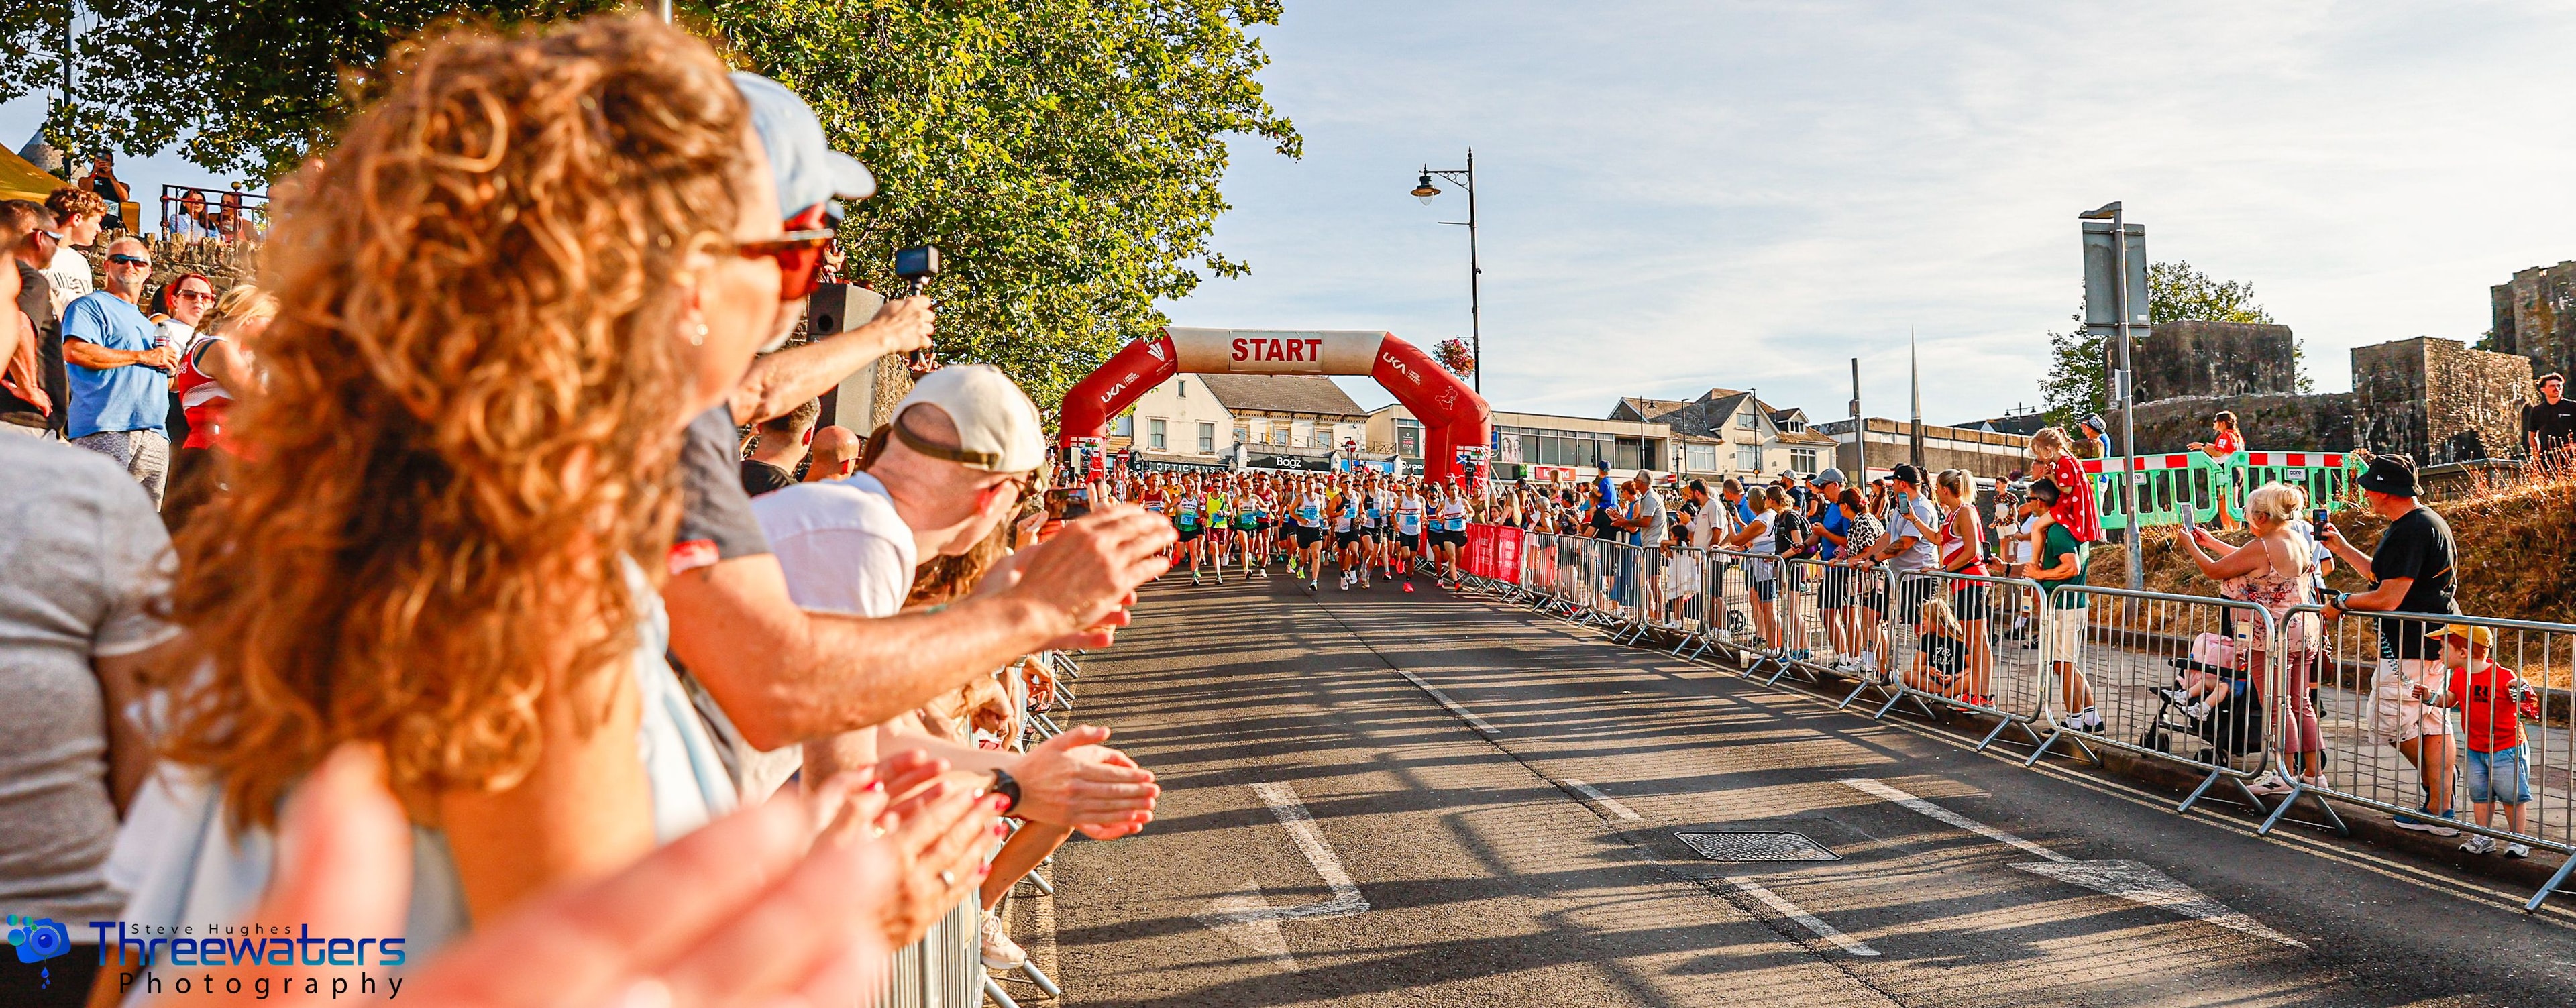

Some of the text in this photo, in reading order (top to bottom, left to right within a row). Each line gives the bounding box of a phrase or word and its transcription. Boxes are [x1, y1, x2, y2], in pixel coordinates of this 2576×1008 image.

[1232, 338, 1322, 362] START
[1382, 351, 1405, 375] UKA
[1100, 382, 1126, 403] UKA
[1156, 463, 1216, 473] OPTICIANS
[1277, 456, 1301, 469] Bagz
[1543, 468, 1570, 478] Icnd
